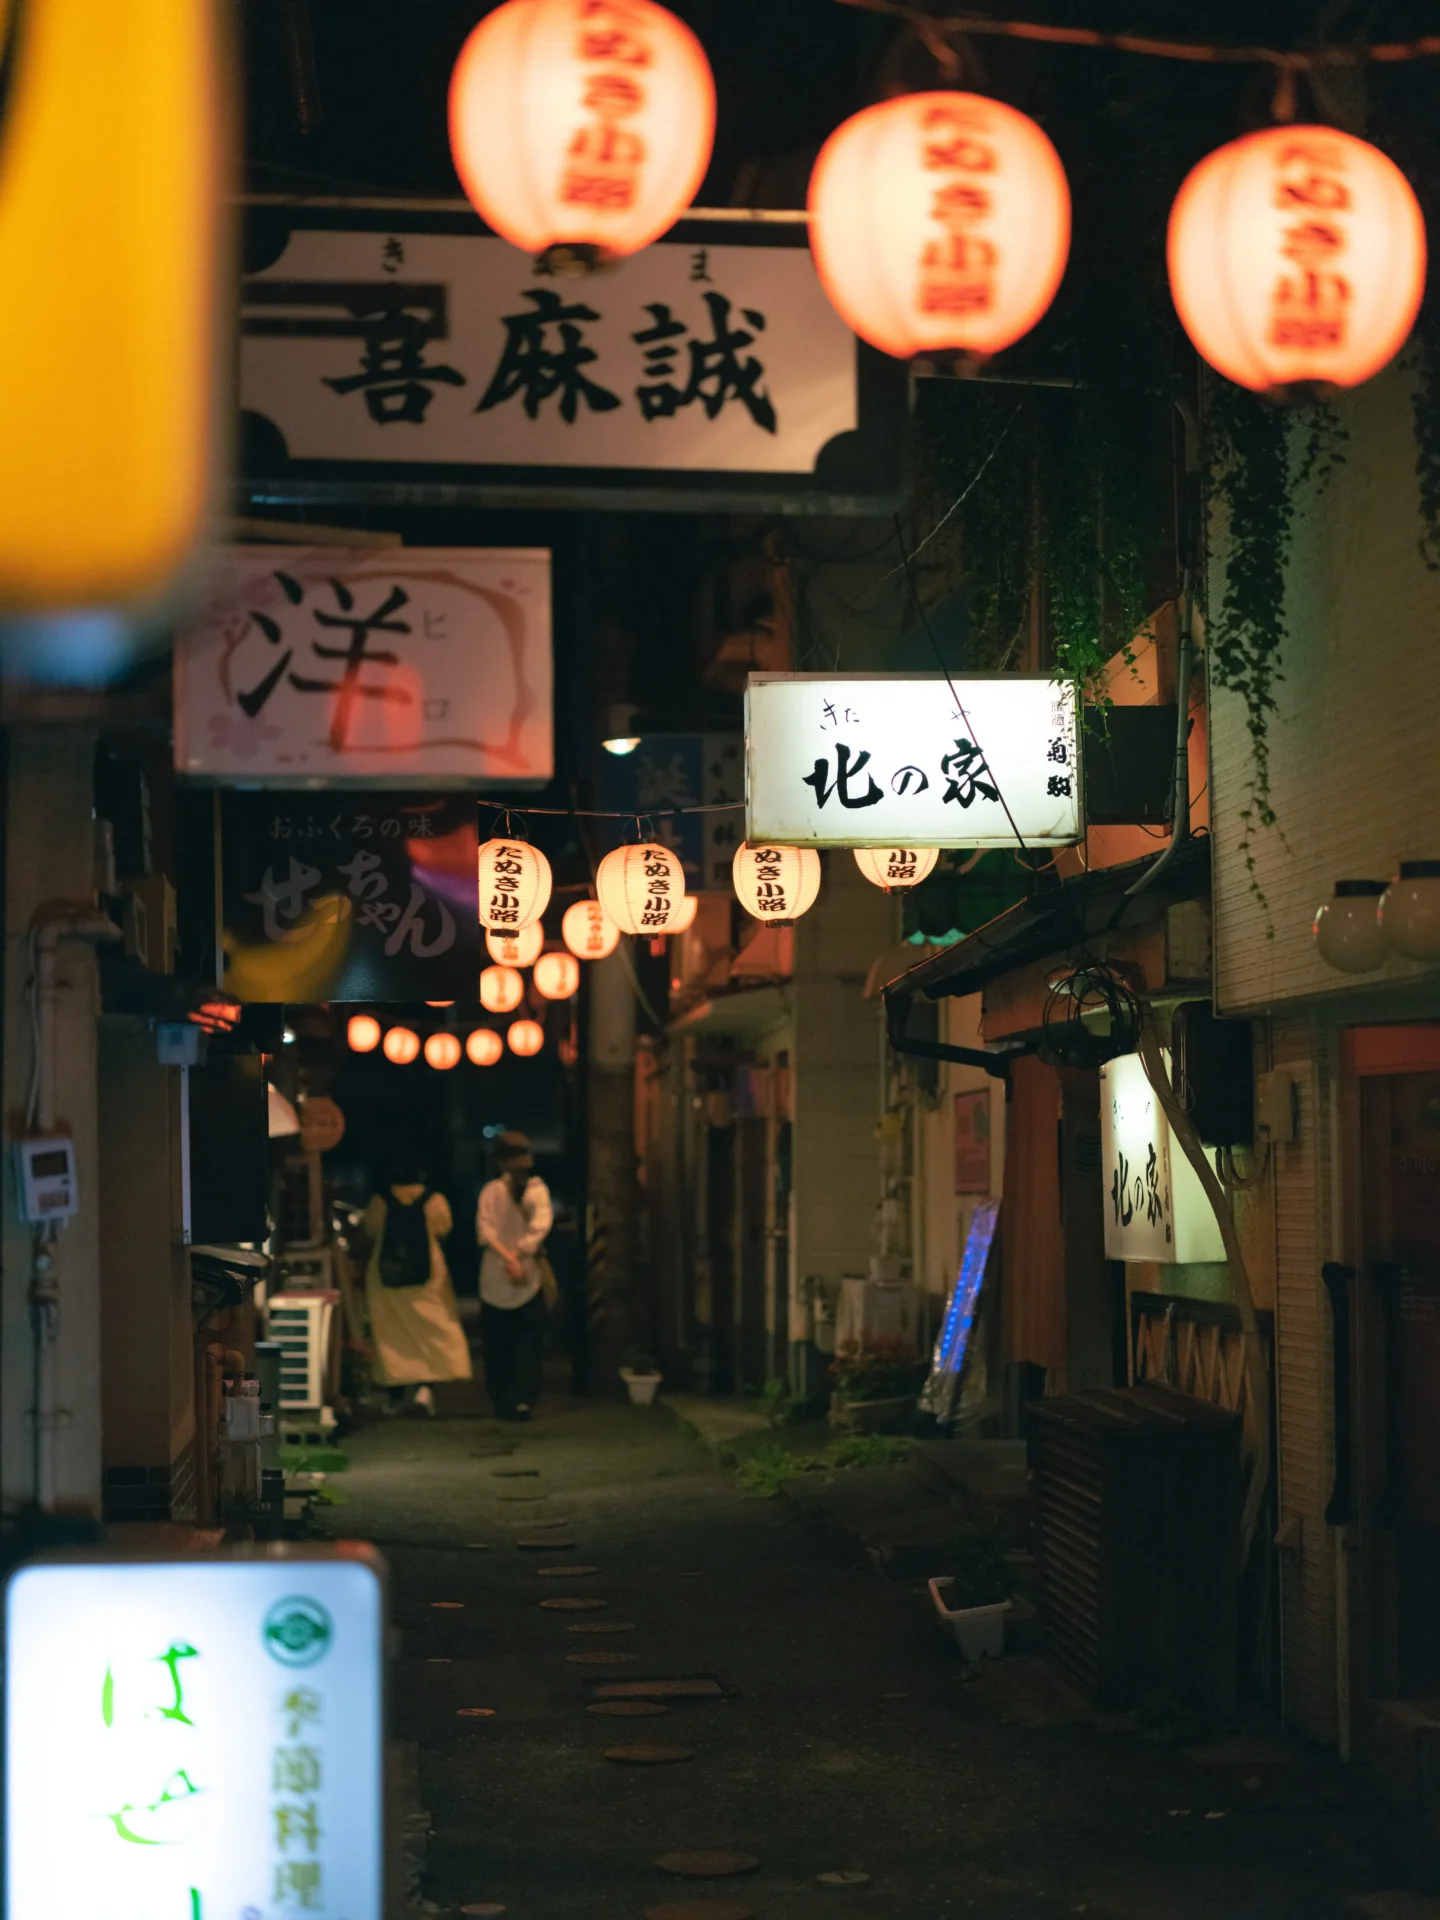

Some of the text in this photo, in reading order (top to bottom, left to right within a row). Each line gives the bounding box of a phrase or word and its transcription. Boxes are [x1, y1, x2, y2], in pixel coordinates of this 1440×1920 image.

[237, 570, 414, 754] 洋
[819, 697, 972, 731] きた や
[801, 737, 1000, 810] 北の家
[269, 813, 435, 841] おふくろの味
[489, 845, 523, 923] たぬき小路
[640, 849, 672, 927] たぬき小路
[1111, 1141, 1163, 1228] 北の家
